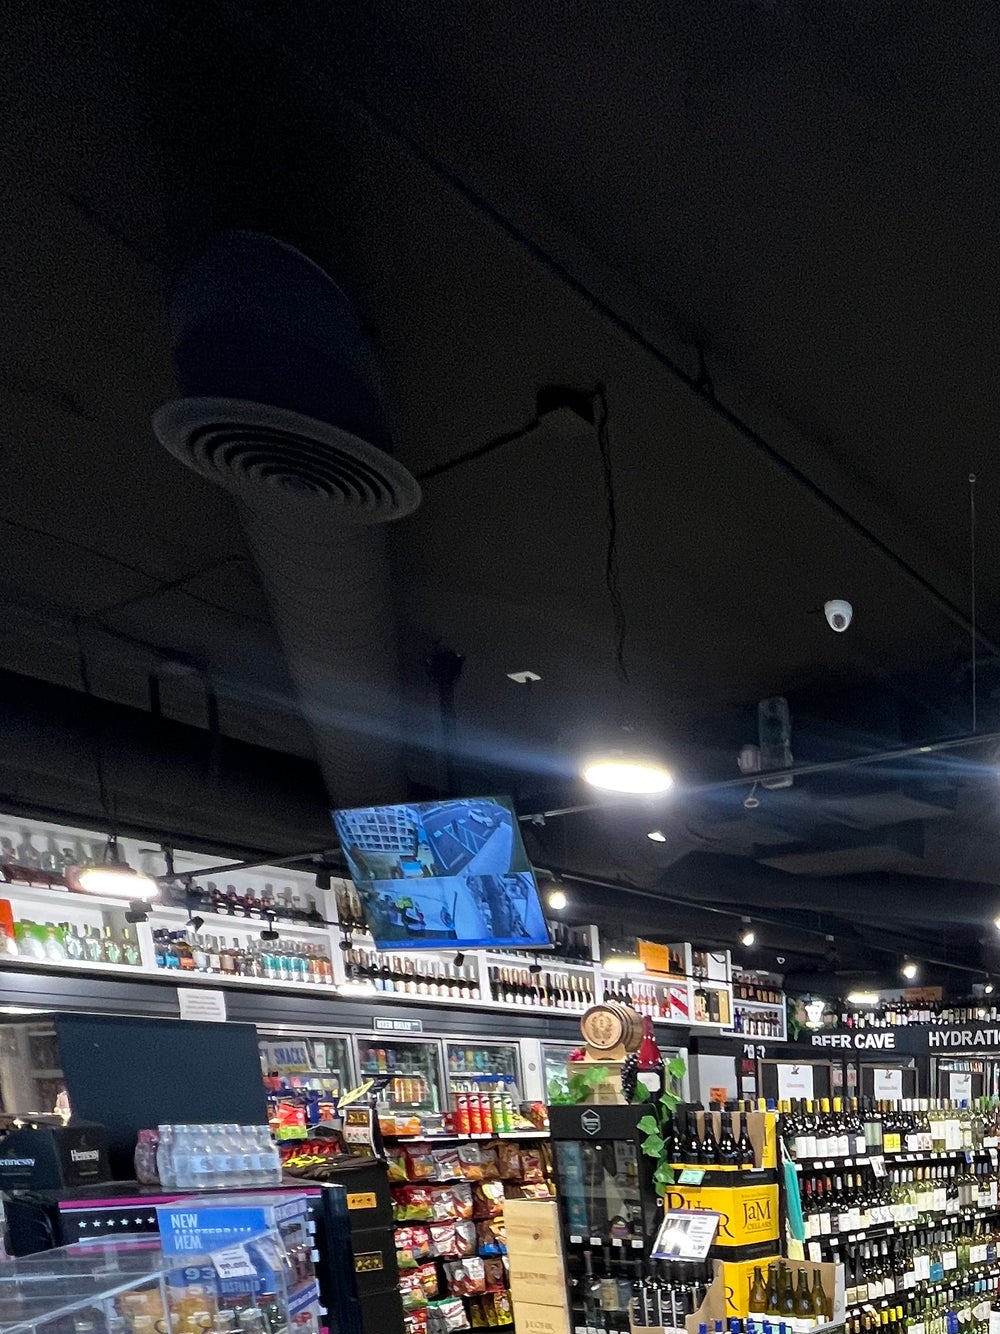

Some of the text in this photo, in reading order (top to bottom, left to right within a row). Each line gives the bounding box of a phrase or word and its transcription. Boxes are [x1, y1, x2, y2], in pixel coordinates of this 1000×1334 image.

[812, 1033, 895, 1049] BEER CAVE
[0, 1158, 35, 1167] ennessy
[170, 1214, 198, 1229] NEW
